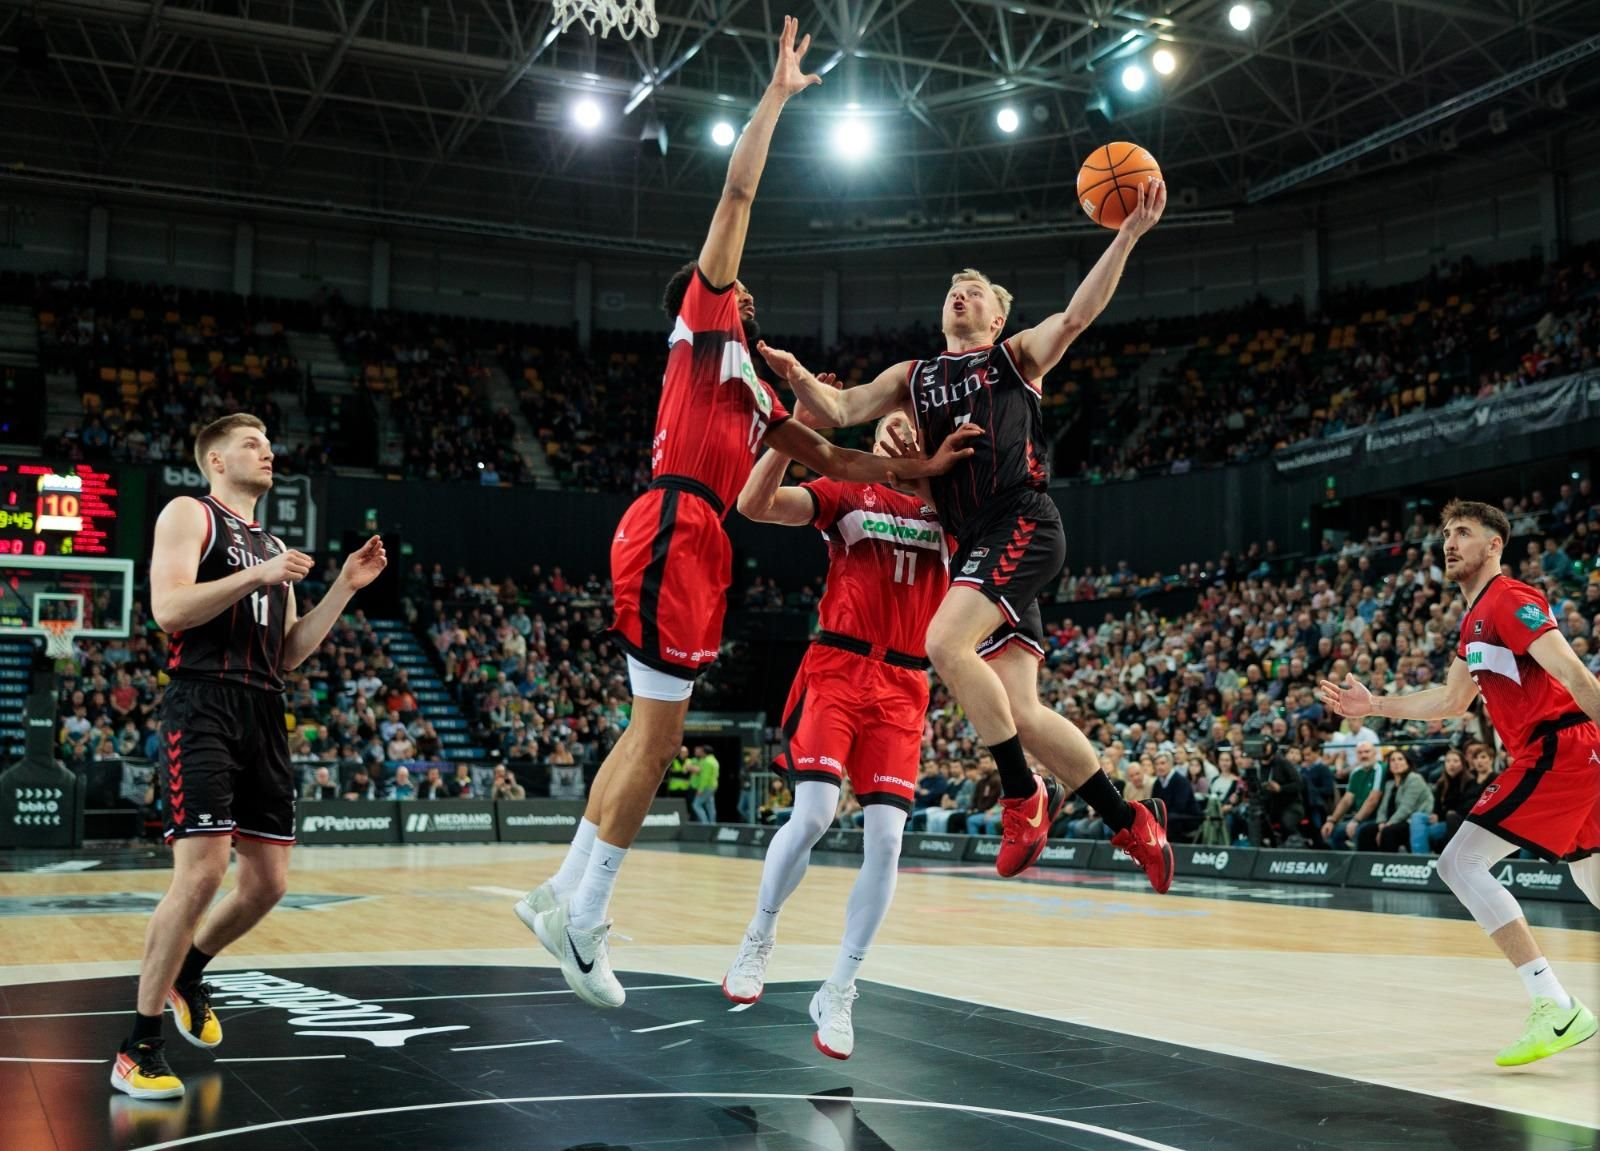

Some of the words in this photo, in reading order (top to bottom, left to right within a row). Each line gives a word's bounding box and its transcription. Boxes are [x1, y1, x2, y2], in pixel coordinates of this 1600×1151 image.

[45, 493, 79, 517] 10
[893, 548, 918, 586] 11
[18, 801, 46, 813] bbk
[325, 815, 392, 831] Petronor
[434, 814, 492, 825] MEDRANO
[506, 813, 576, 826] azulmarino
[1269, 861, 1329, 875] NISSAN
[1370, 863, 1384, 877] EL
[1385, 864, 1432, 879] CORREO
[1515, 869, 1563, 886] agaleus
